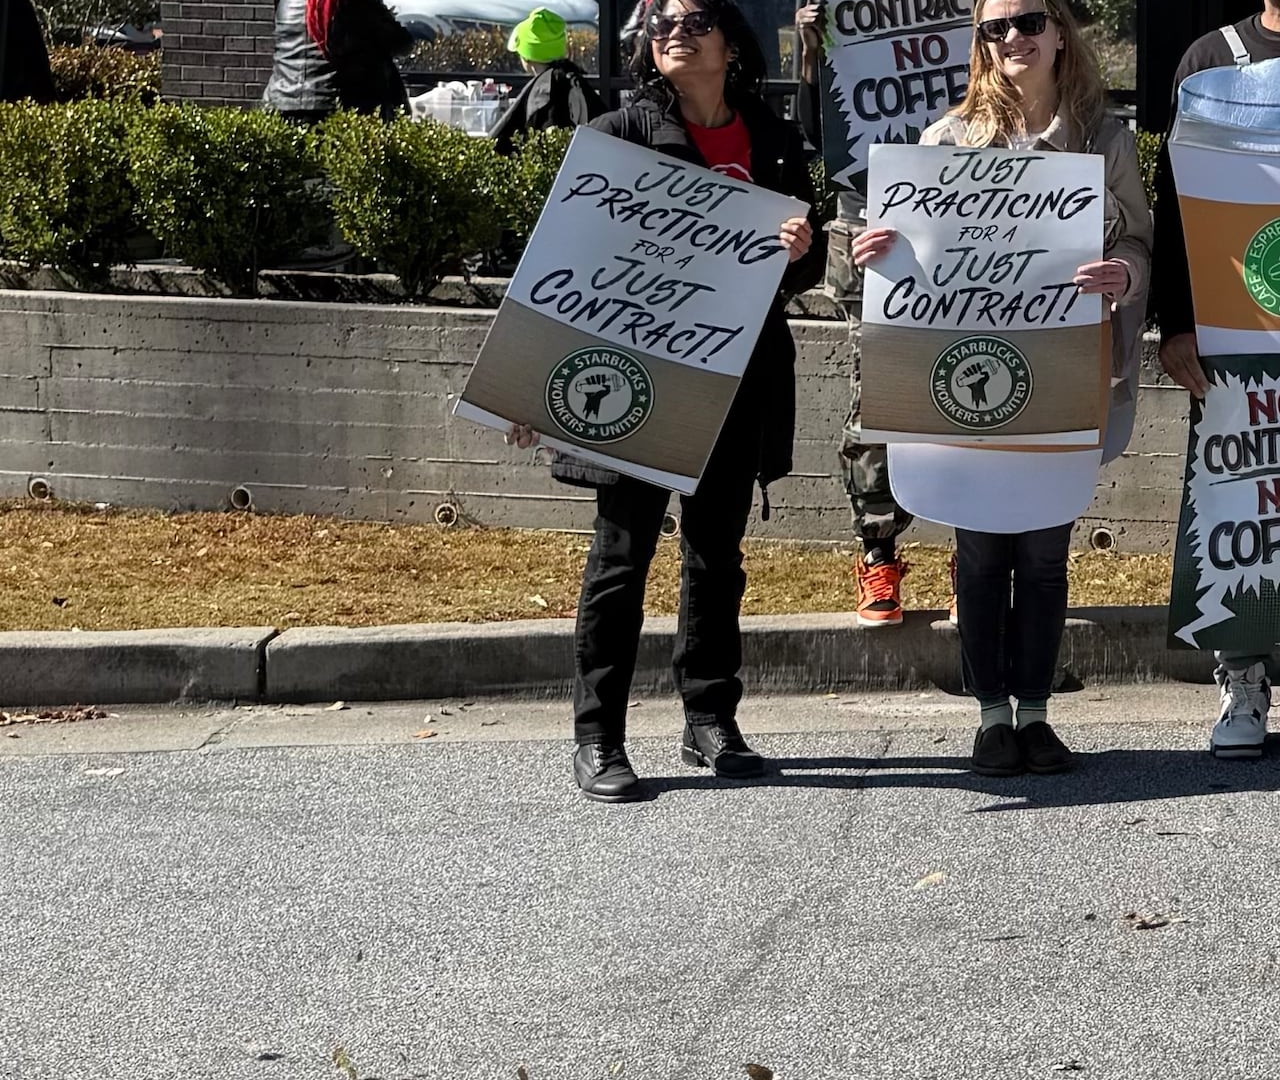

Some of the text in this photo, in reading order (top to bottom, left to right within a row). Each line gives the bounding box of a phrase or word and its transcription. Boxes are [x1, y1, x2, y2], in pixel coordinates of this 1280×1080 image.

[891, 34, 949, 71] NO
[853, 64, 969, 121] COFFE
[635, 161, 749, 211] JUST
[939, 151, 1045, 185] JUST
[561, 173, 787, 264] PRACTICING
[879, 182, 1099, 220] PRACTICING
[958, 225, 1017, 242] FOR A
[630, 239, 694, 269] FOR A
[933, 247, 1048, 286] JUST
[592, 256, 715, 312] JUST
[883, 276, 1082, 326] CONTRACT!
[1249, 274, 1276, 308] CAFE
[531, 269, 743, 363] CONTRACT!
[575, 352, 646, 390] STARBUCKS
[946, 341, 1020, 367] STARBUCKS
[551, 379, 644, 437] WORKERS UNITED
[937, 379, 1027, 422] WORKERS UNITED
